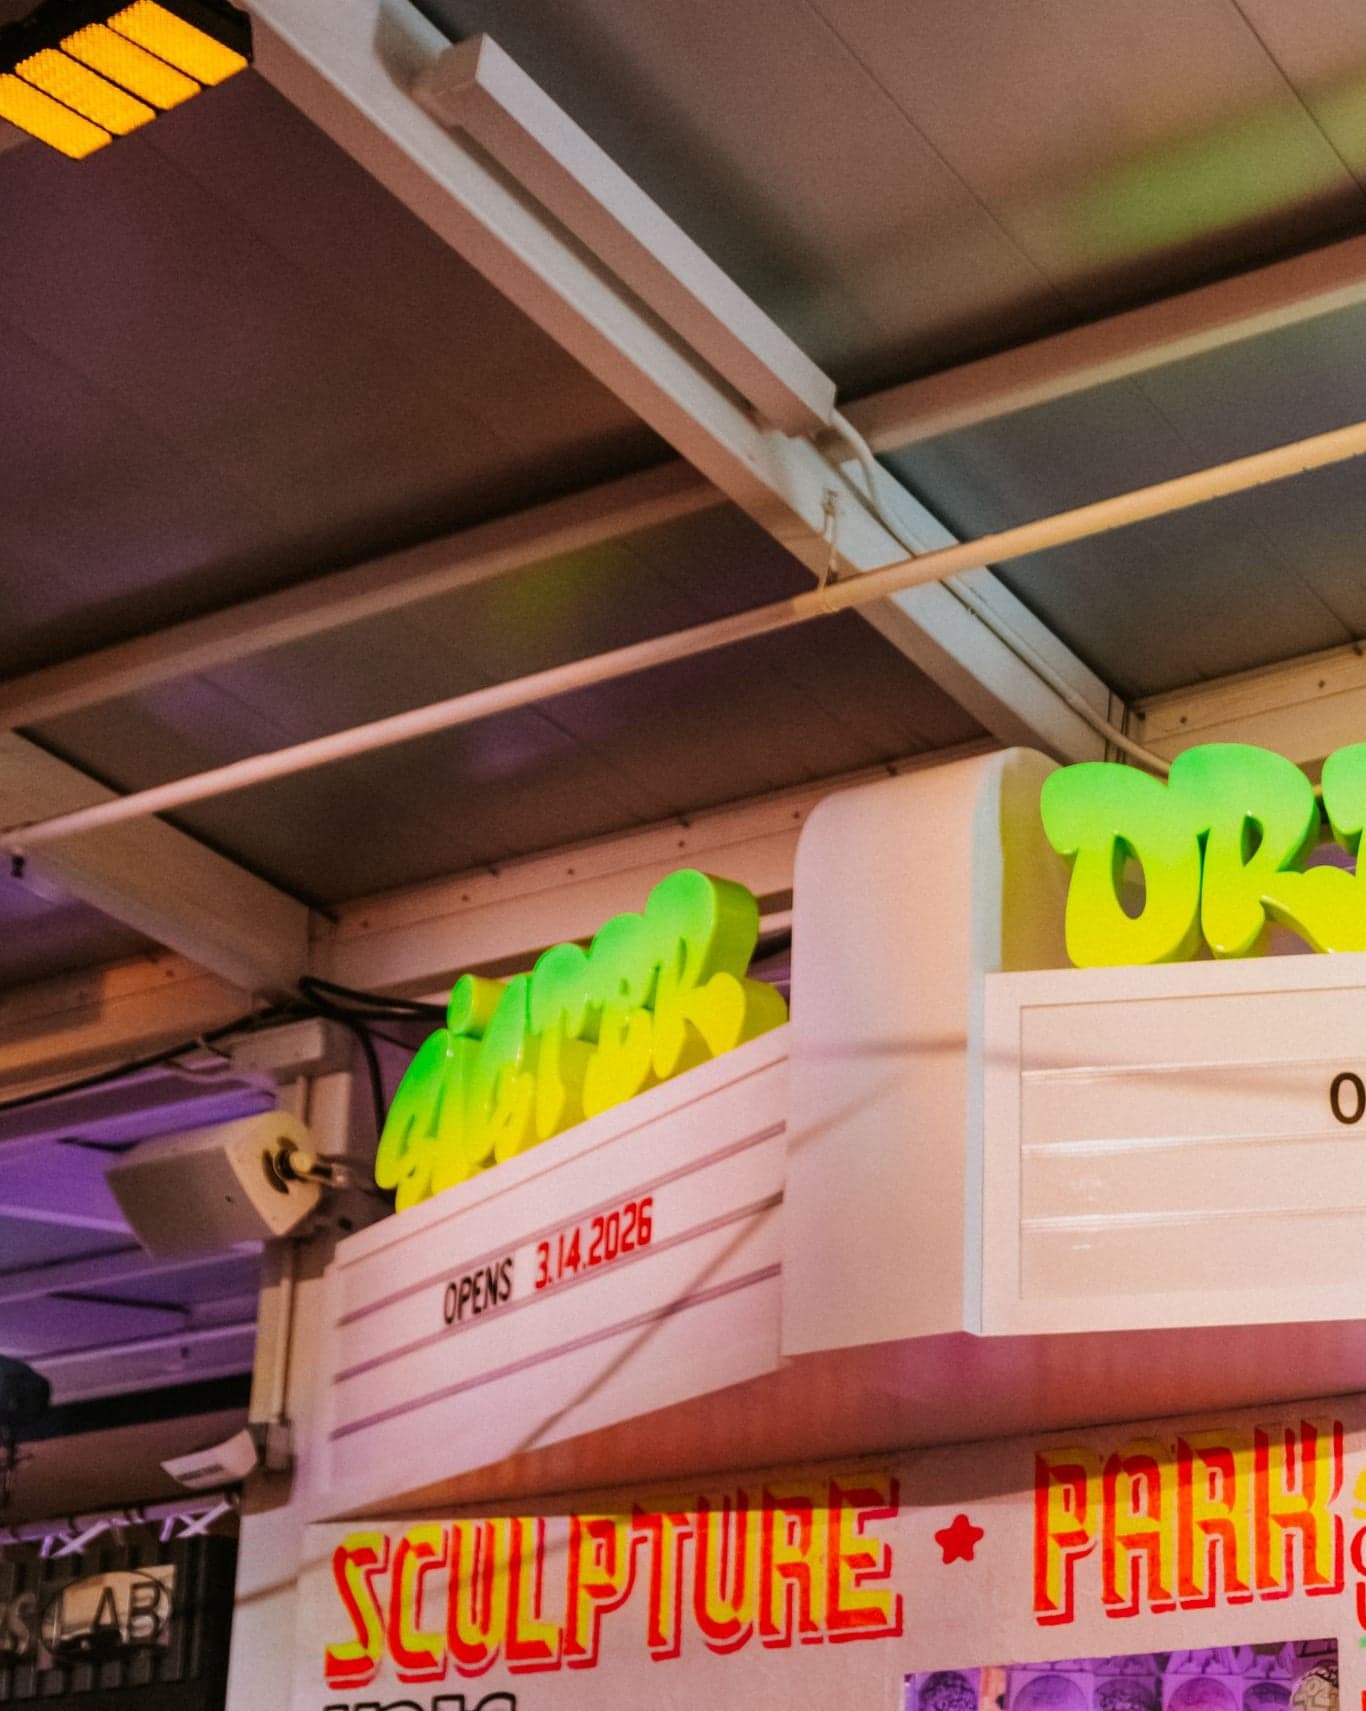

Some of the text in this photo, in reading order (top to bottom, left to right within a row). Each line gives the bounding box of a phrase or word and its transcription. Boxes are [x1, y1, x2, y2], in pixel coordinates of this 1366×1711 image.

[443, 1196, 654, 1326] OPENS 3.14.2026
[324, 1474, 904, 1689] SCULPTURE
[1032, 1414, 1345, 1626] PARK
